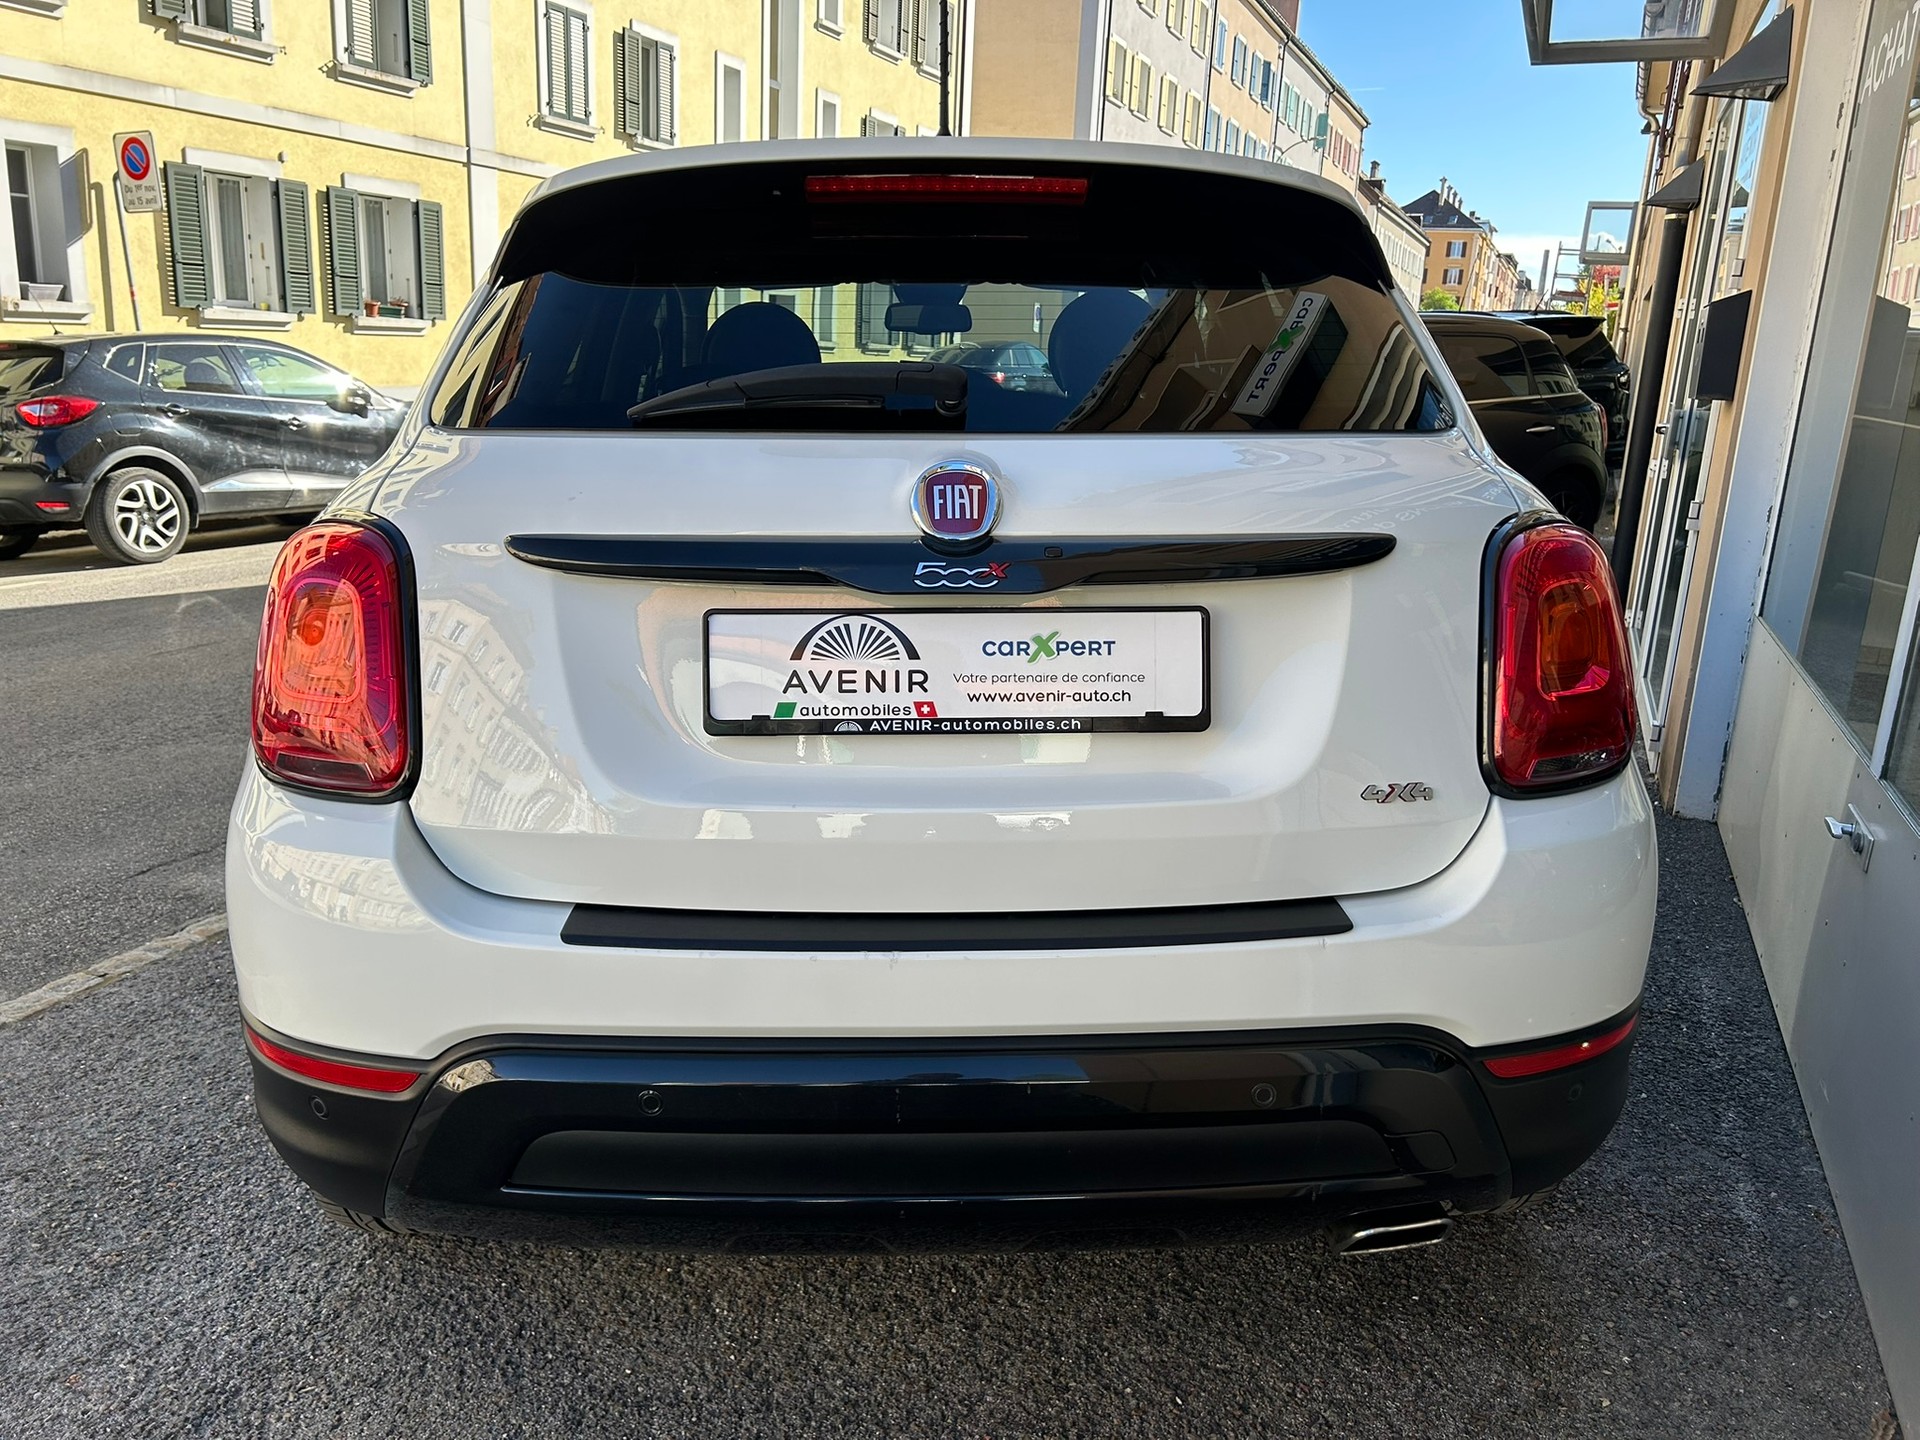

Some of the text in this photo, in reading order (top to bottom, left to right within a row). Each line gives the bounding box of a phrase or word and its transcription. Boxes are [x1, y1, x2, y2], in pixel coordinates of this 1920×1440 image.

[124, 184, 134, 194] Du
[128, 195, 158, 206] au 15 avril
[933, 485, 983, 519] FIAT
[913, 562, 1011, 588] 500X
[782, 669, 929, 694] AVENIR
[953, 672, 1146, 685] Votre partenaire de confiance
[967, 690, 1132, 702] www.avenir-auto.ch
[799, 703, 912, 717] automobiles
[869, 718, 1081, 731] AVENIR-automobiles.ch
